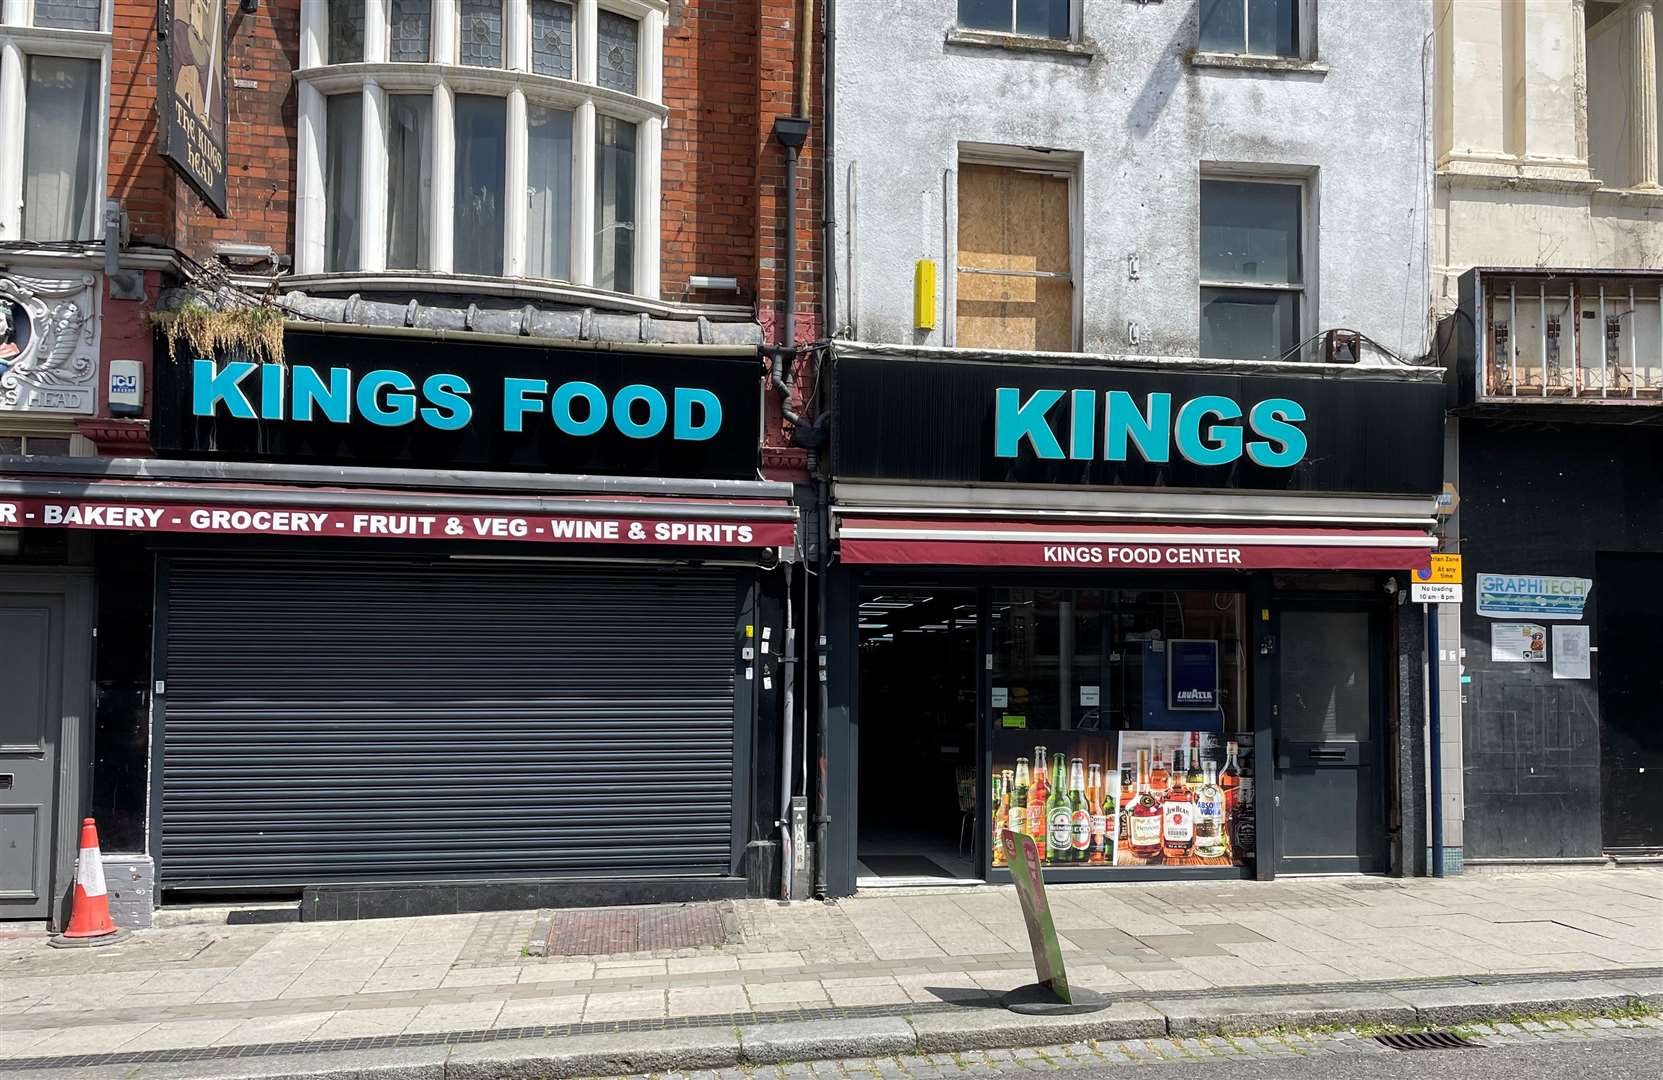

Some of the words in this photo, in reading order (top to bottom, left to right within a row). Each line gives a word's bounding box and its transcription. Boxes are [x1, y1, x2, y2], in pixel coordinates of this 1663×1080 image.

[28, 389, 82, 409] HEAD
[193, 359, 472, 431] KINGS
[504, 377, 723, 441] FOOD
[995, 387, 1308, 468] KINGS
[44, 505, 165, 528] BAKERY
[190, 510, 329, 532] GROCERY
[353, 514, 436, 535] FRUIT
[444, 516, 465, 536] &
[472, 517, 528, 537] VEG
[551, 520, 619, 540] WINE
[627, 521, 647, 541] &
[654, 522, 754, 543] SPIRITS
[1043, 546, 1102, 563] KINGS
[1108, 547, 1161, 564] FOOD
[1165, 548, 1242, 564] CENTER
[1431, 585, 1453, 593] loading
[1483, 576, 1584, 595] GRAPHITECH
